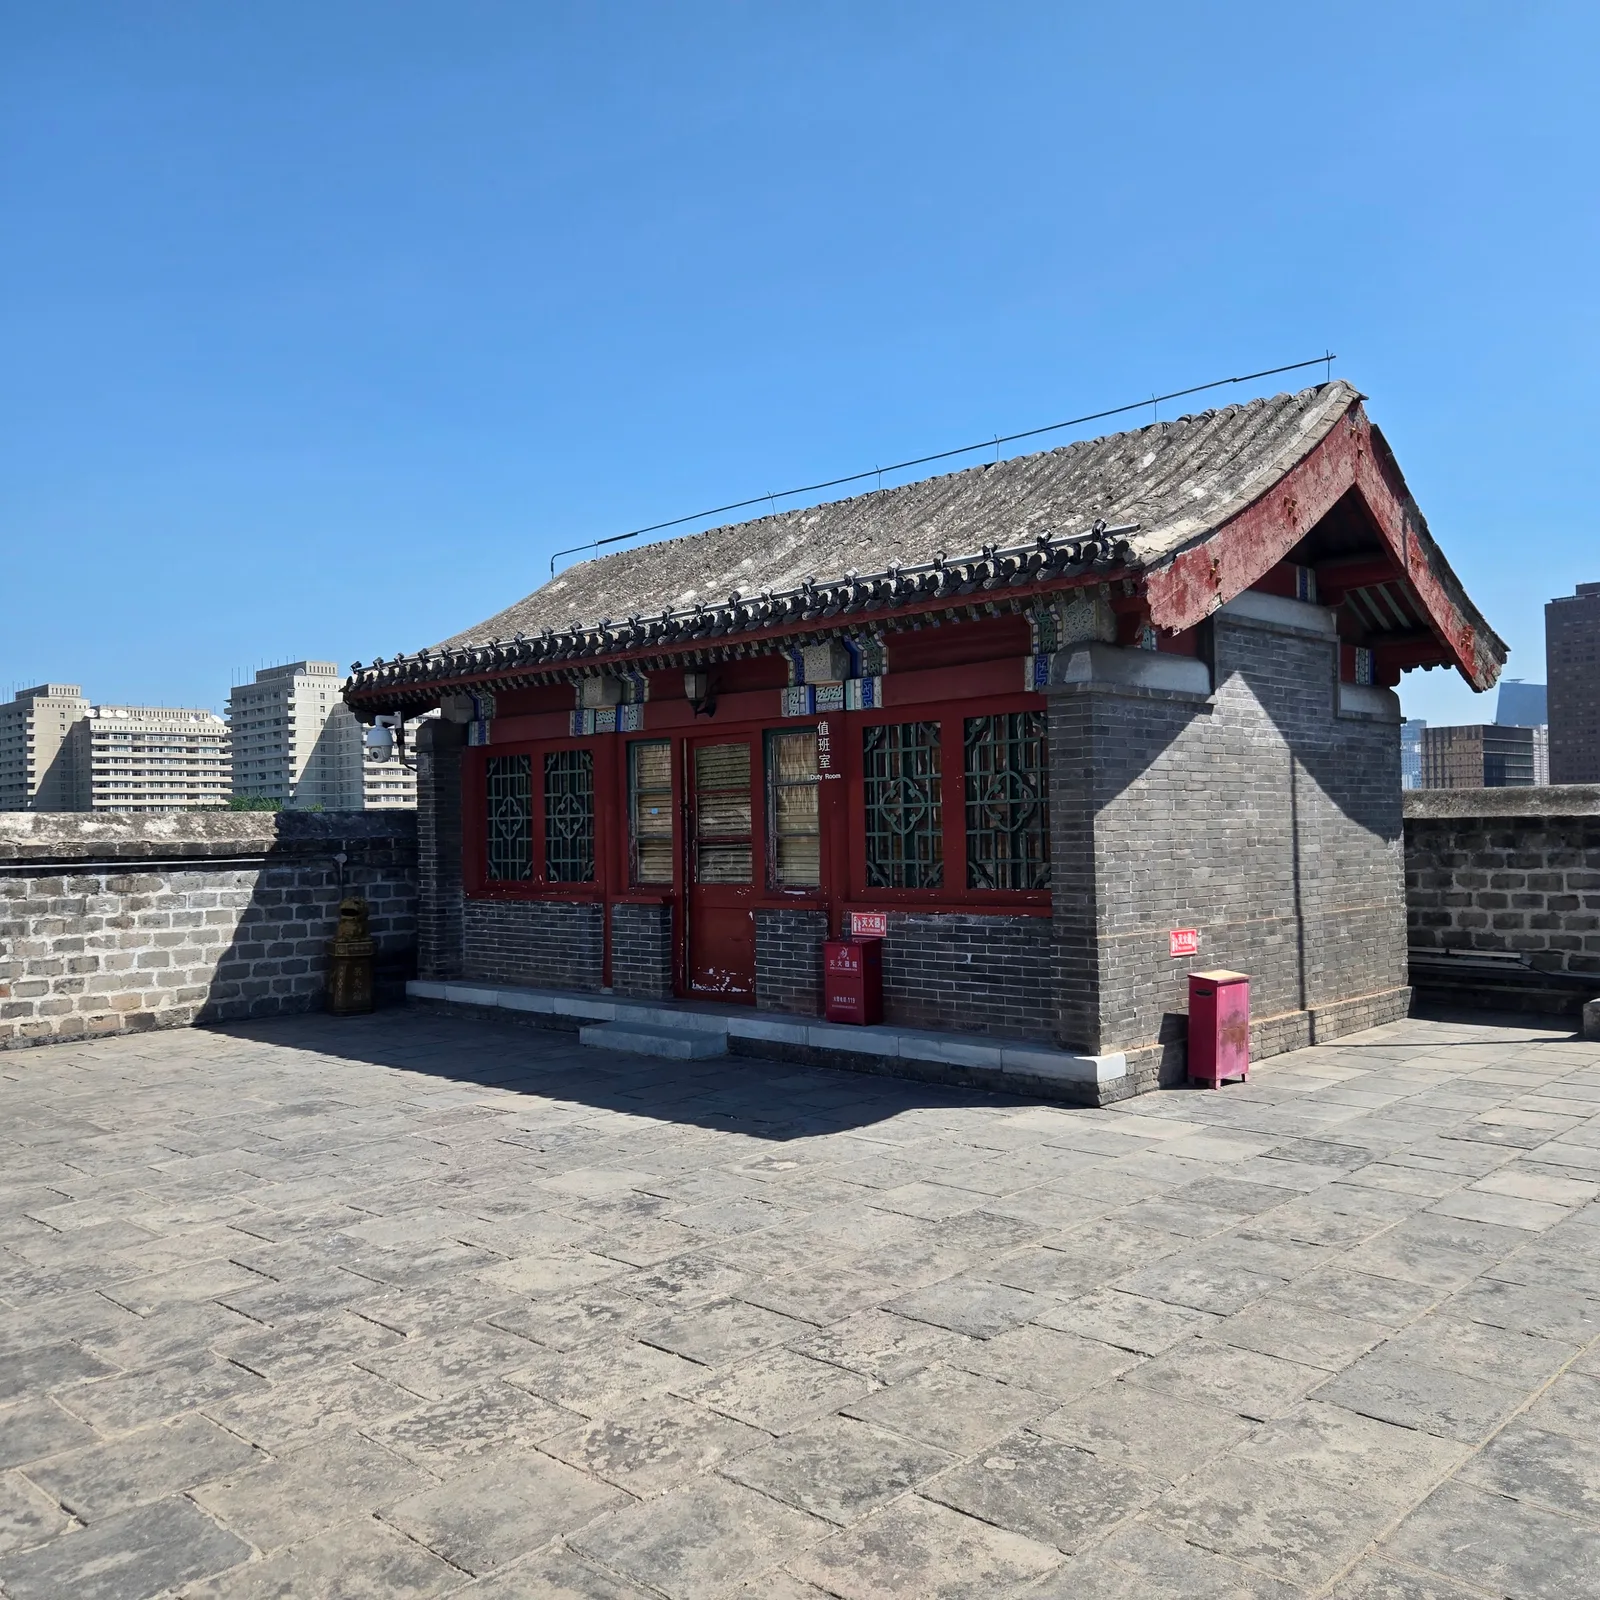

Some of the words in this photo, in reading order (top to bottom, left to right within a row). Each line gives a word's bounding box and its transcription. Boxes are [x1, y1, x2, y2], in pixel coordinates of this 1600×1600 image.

[817, 720, 831, 769] 值班室
[861, 917, 880, 928] 灭火器
[1177, 932, 1192, 944] 灭火器
